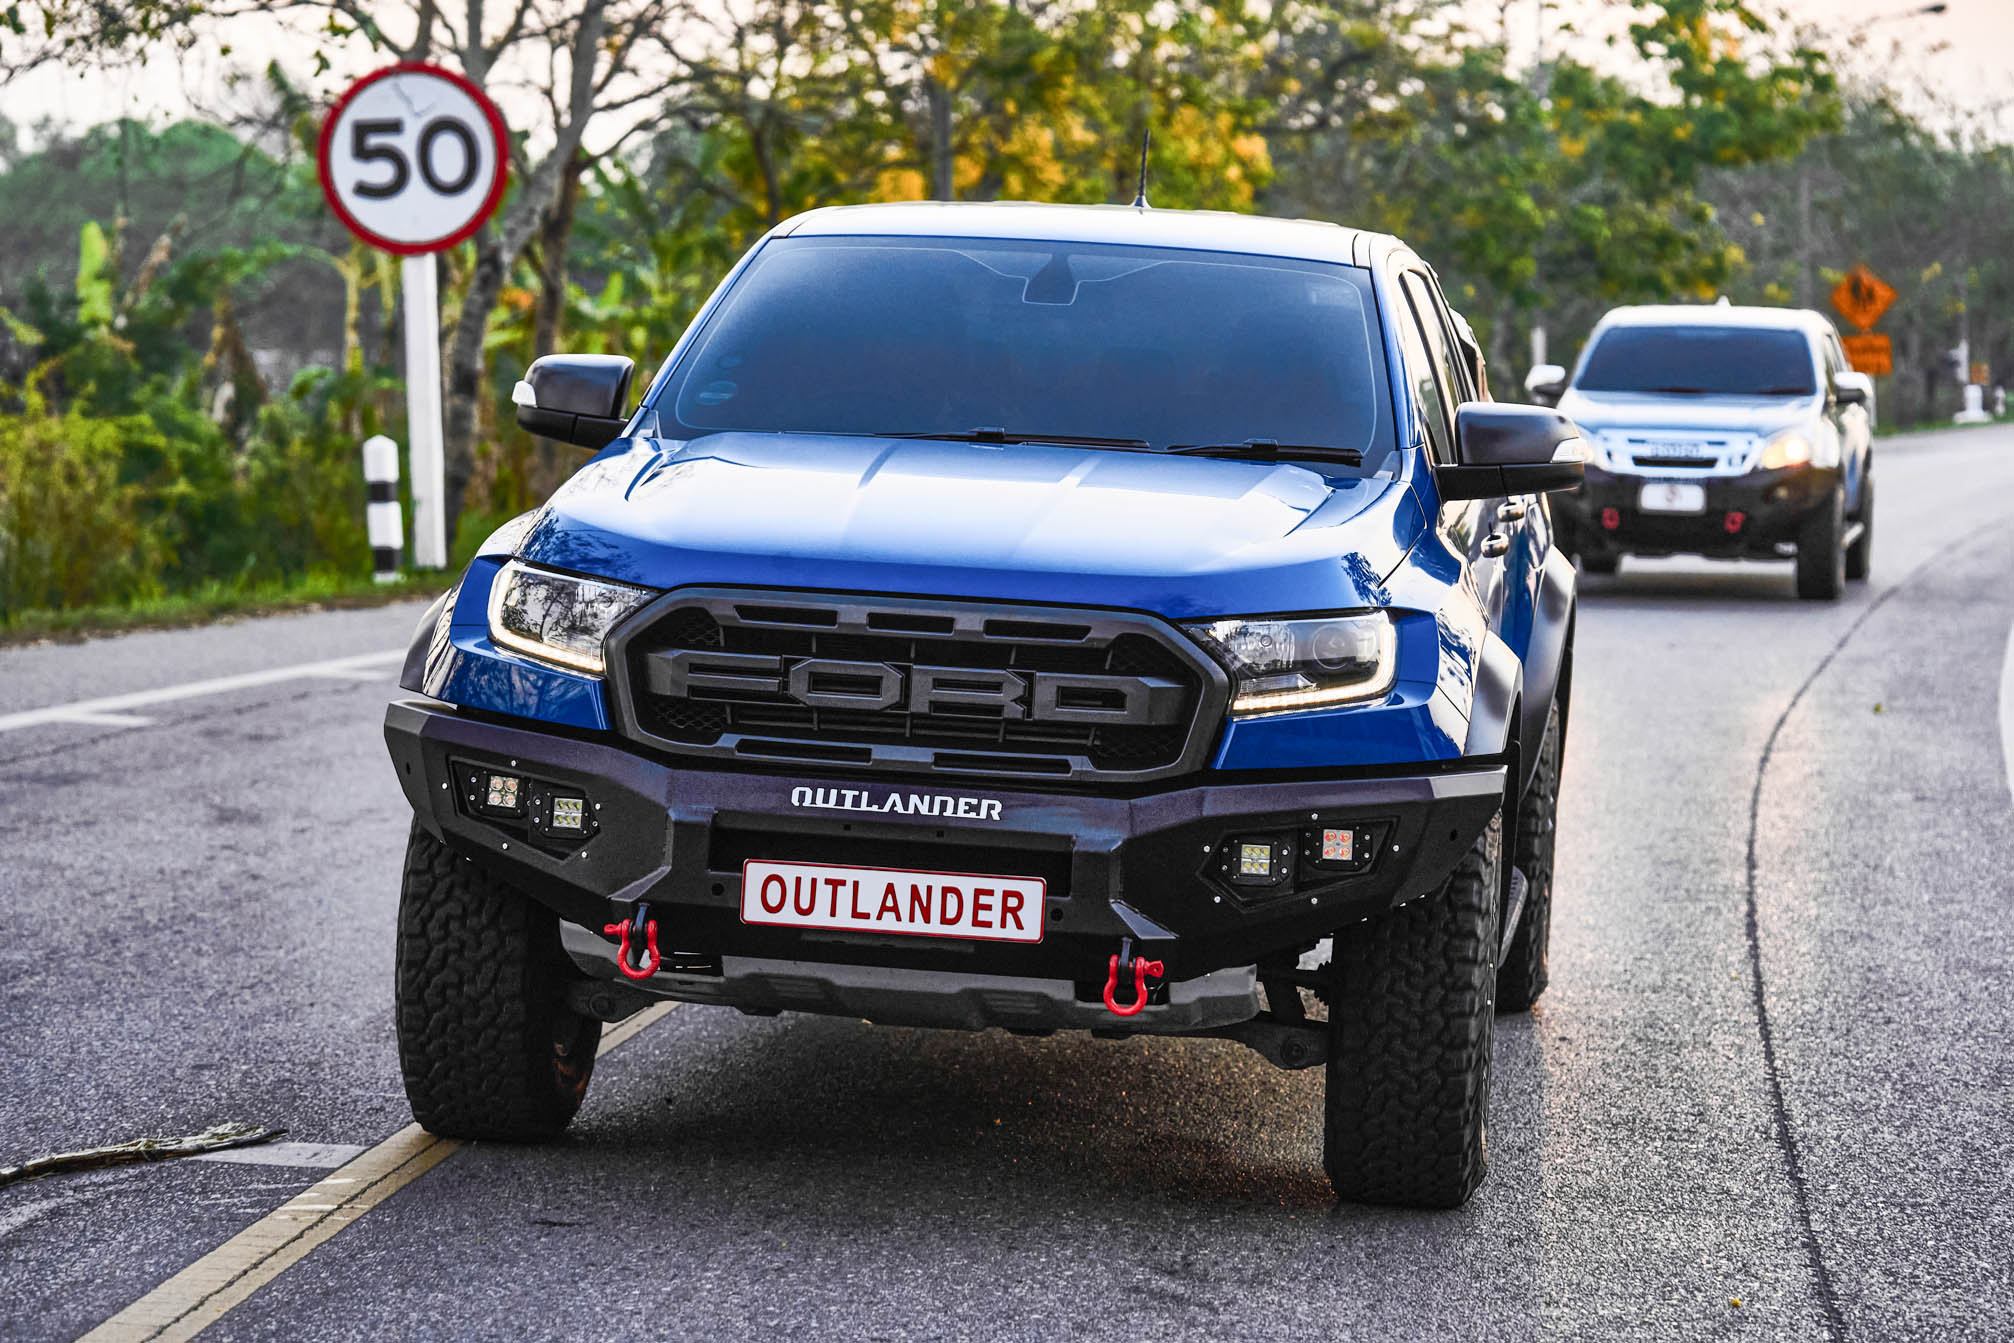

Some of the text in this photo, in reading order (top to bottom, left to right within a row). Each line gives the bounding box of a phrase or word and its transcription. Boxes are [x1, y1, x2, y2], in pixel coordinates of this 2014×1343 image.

[352, 115, 481, 200] 50
[648, 650, 1184, 726] FORD
[791, 786, 1003, 821] OUTLANDER
[760, 873, 1025, 931] OUTLANDER
